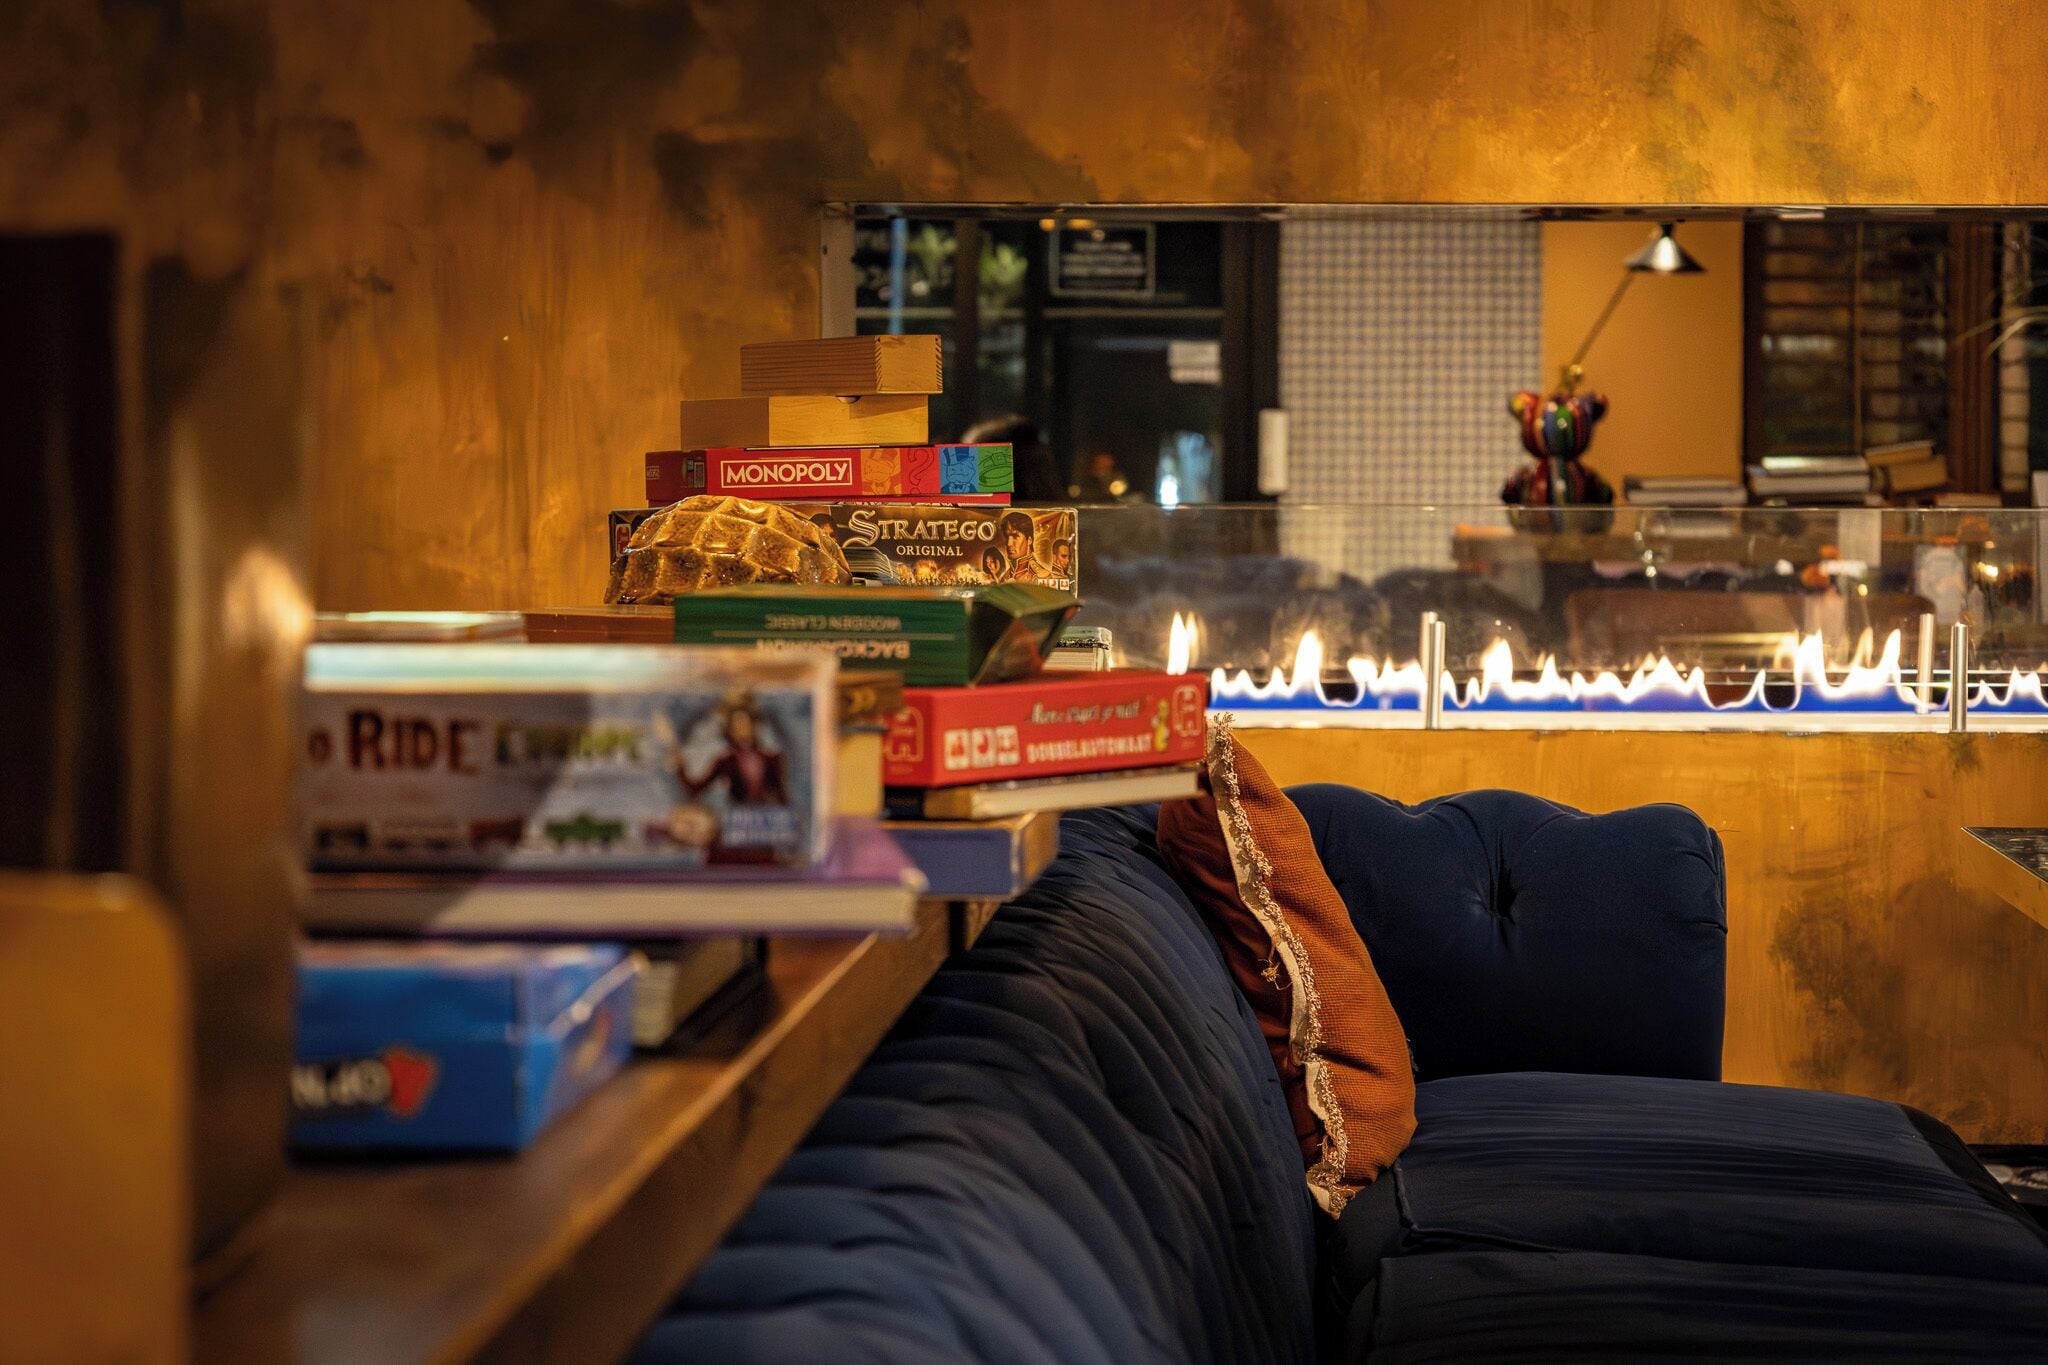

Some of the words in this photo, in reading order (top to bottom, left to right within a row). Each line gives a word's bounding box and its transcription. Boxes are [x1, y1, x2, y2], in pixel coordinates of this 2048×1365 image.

[726, 462, 848, 484] MONOPOLY
[843, 509, 996, 547] STRATEGO
[896, 545, 964, 557] ORIGINAL
[347, 708, 481, 777] RIDE
